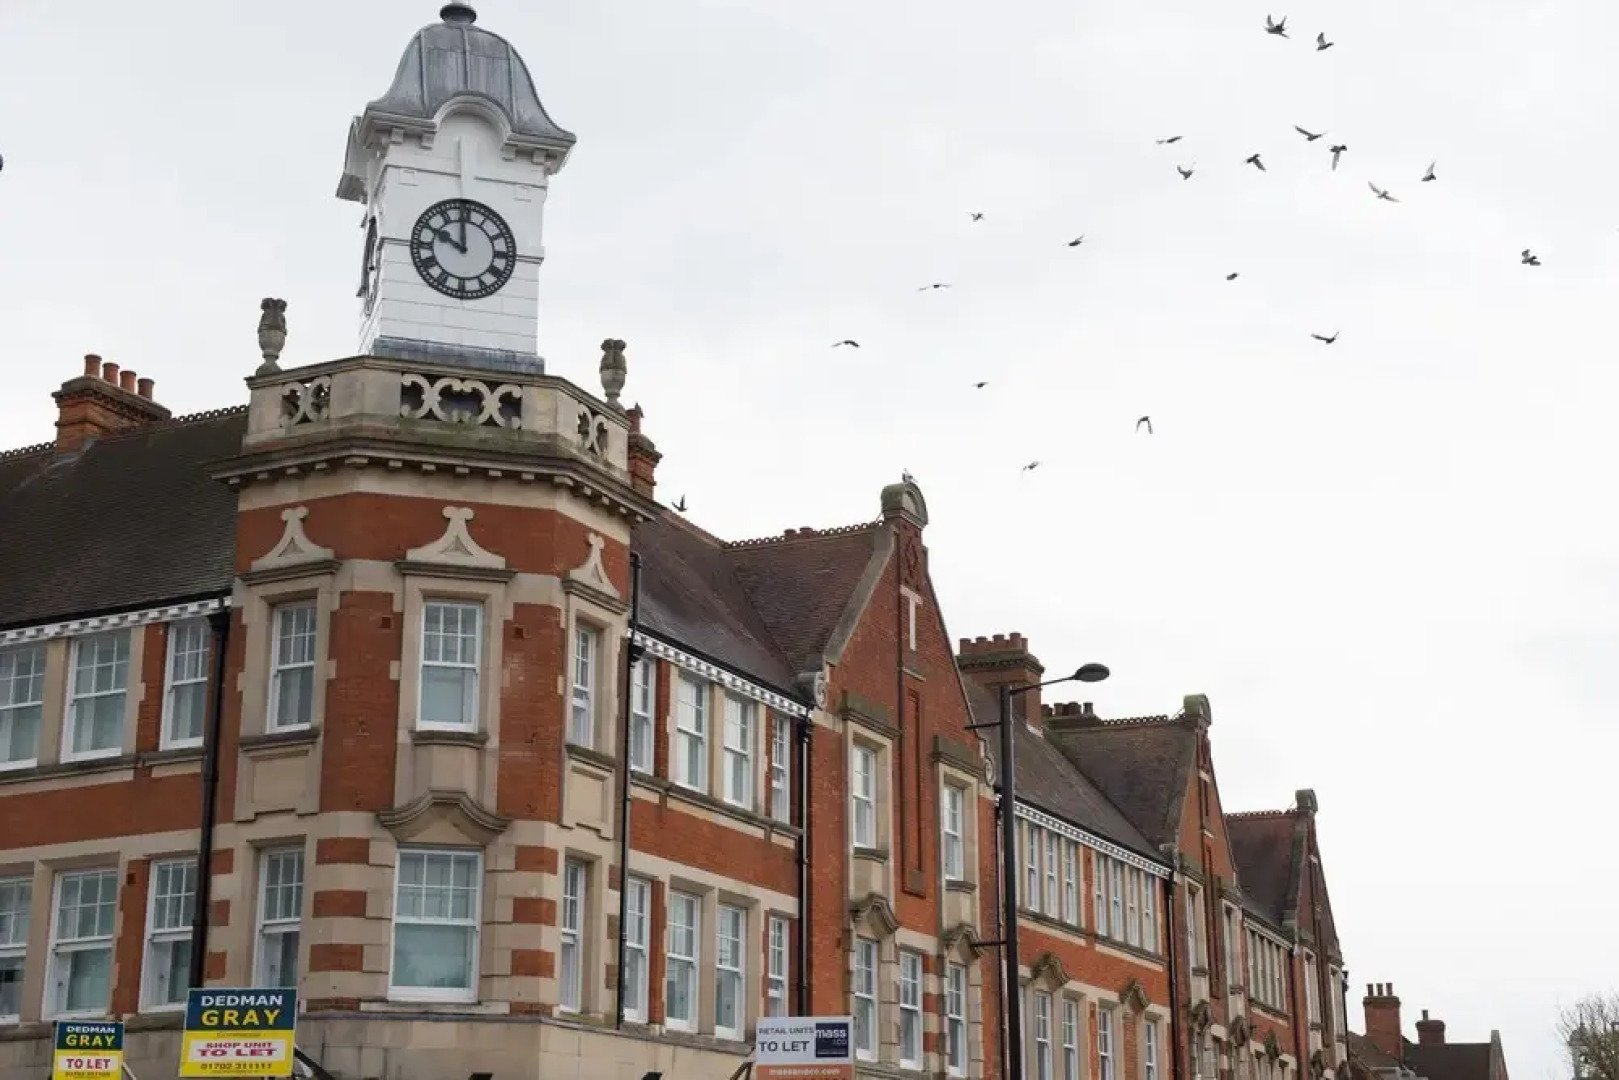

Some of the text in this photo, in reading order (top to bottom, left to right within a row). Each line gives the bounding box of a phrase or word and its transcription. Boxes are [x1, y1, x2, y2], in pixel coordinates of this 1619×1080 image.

[200, 995, 283, 1007] DEDMAN
[201, 1009, 281, 1026] GRAY
[66, 1025, 116, 1033] DEDMAN
[815, 1028, 847, 1039] mass
[66, 1034, 115, 1047] GRAY
[758, 1041, 778, 1052] TO
[781, 1041, 810, 1052] LET
[196, 1048, 278, 1057] TO LET
[65, 1058, 111, 1070] TO LET
